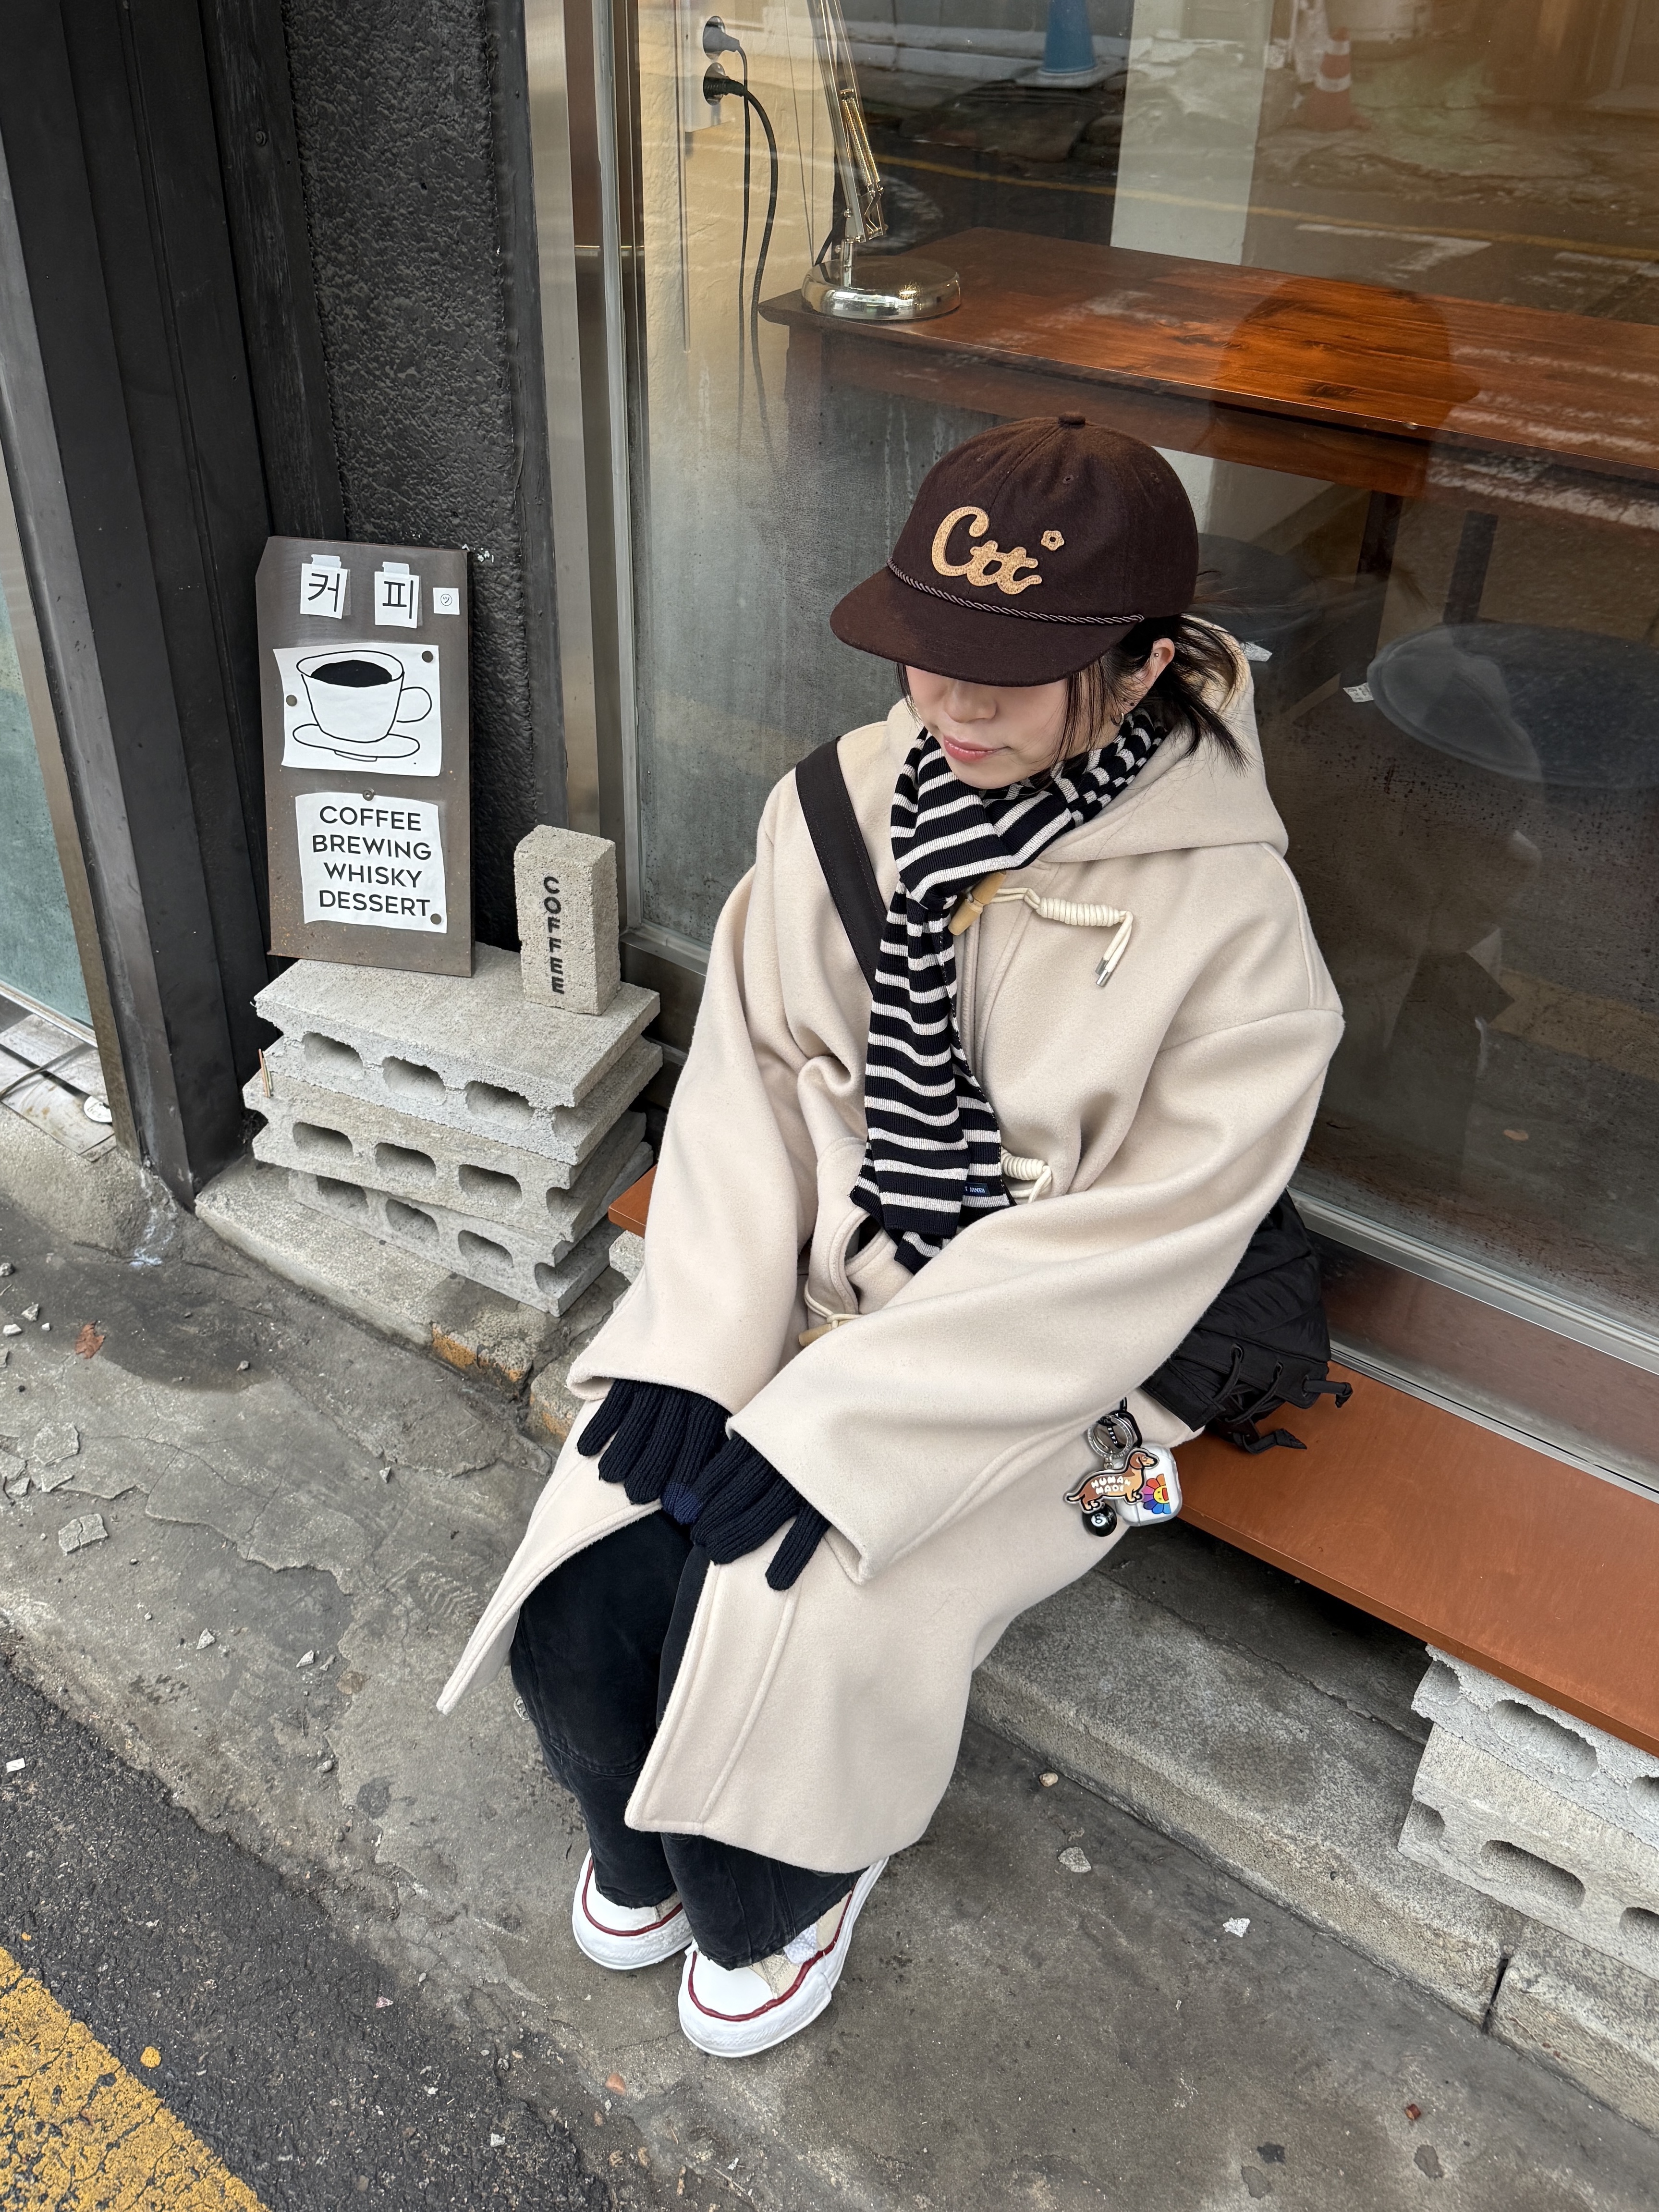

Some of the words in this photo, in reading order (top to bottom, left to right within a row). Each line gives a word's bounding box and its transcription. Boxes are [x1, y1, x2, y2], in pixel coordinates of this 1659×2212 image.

[308, 573, 414, 619] 커피
[319, 806, 421, 831] COFFEE
[312, 834, 432, 860] BREWING
[323, 862, 423, 888] WHISKY
[319, 890, 430, 916] DESSERT
[543, 876, 565, 995] COFFEE
[1091, 1476, 1131, 1488] HUMAN
[1096, 1484, 1124, 1495] MADE
